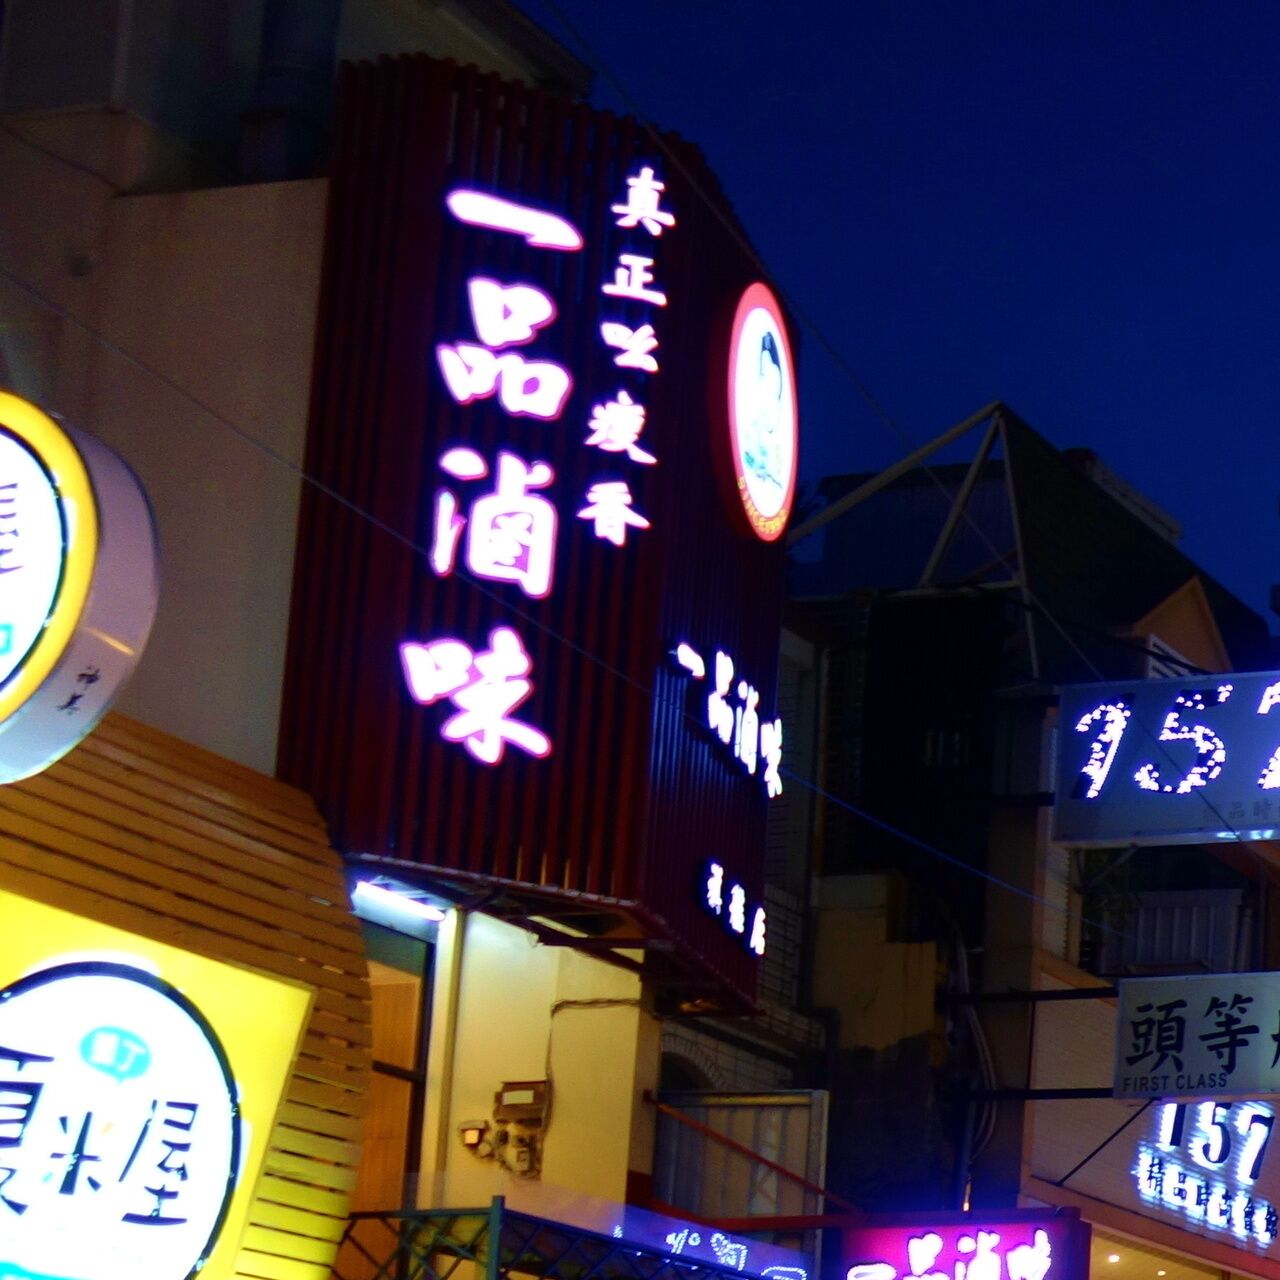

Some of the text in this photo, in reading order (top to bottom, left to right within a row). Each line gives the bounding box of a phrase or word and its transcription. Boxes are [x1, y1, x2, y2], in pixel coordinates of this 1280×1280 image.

[399, 188, 584, 765] 一品滷味
[1123, 1071, 1228, 1093] FIRST CLASS
